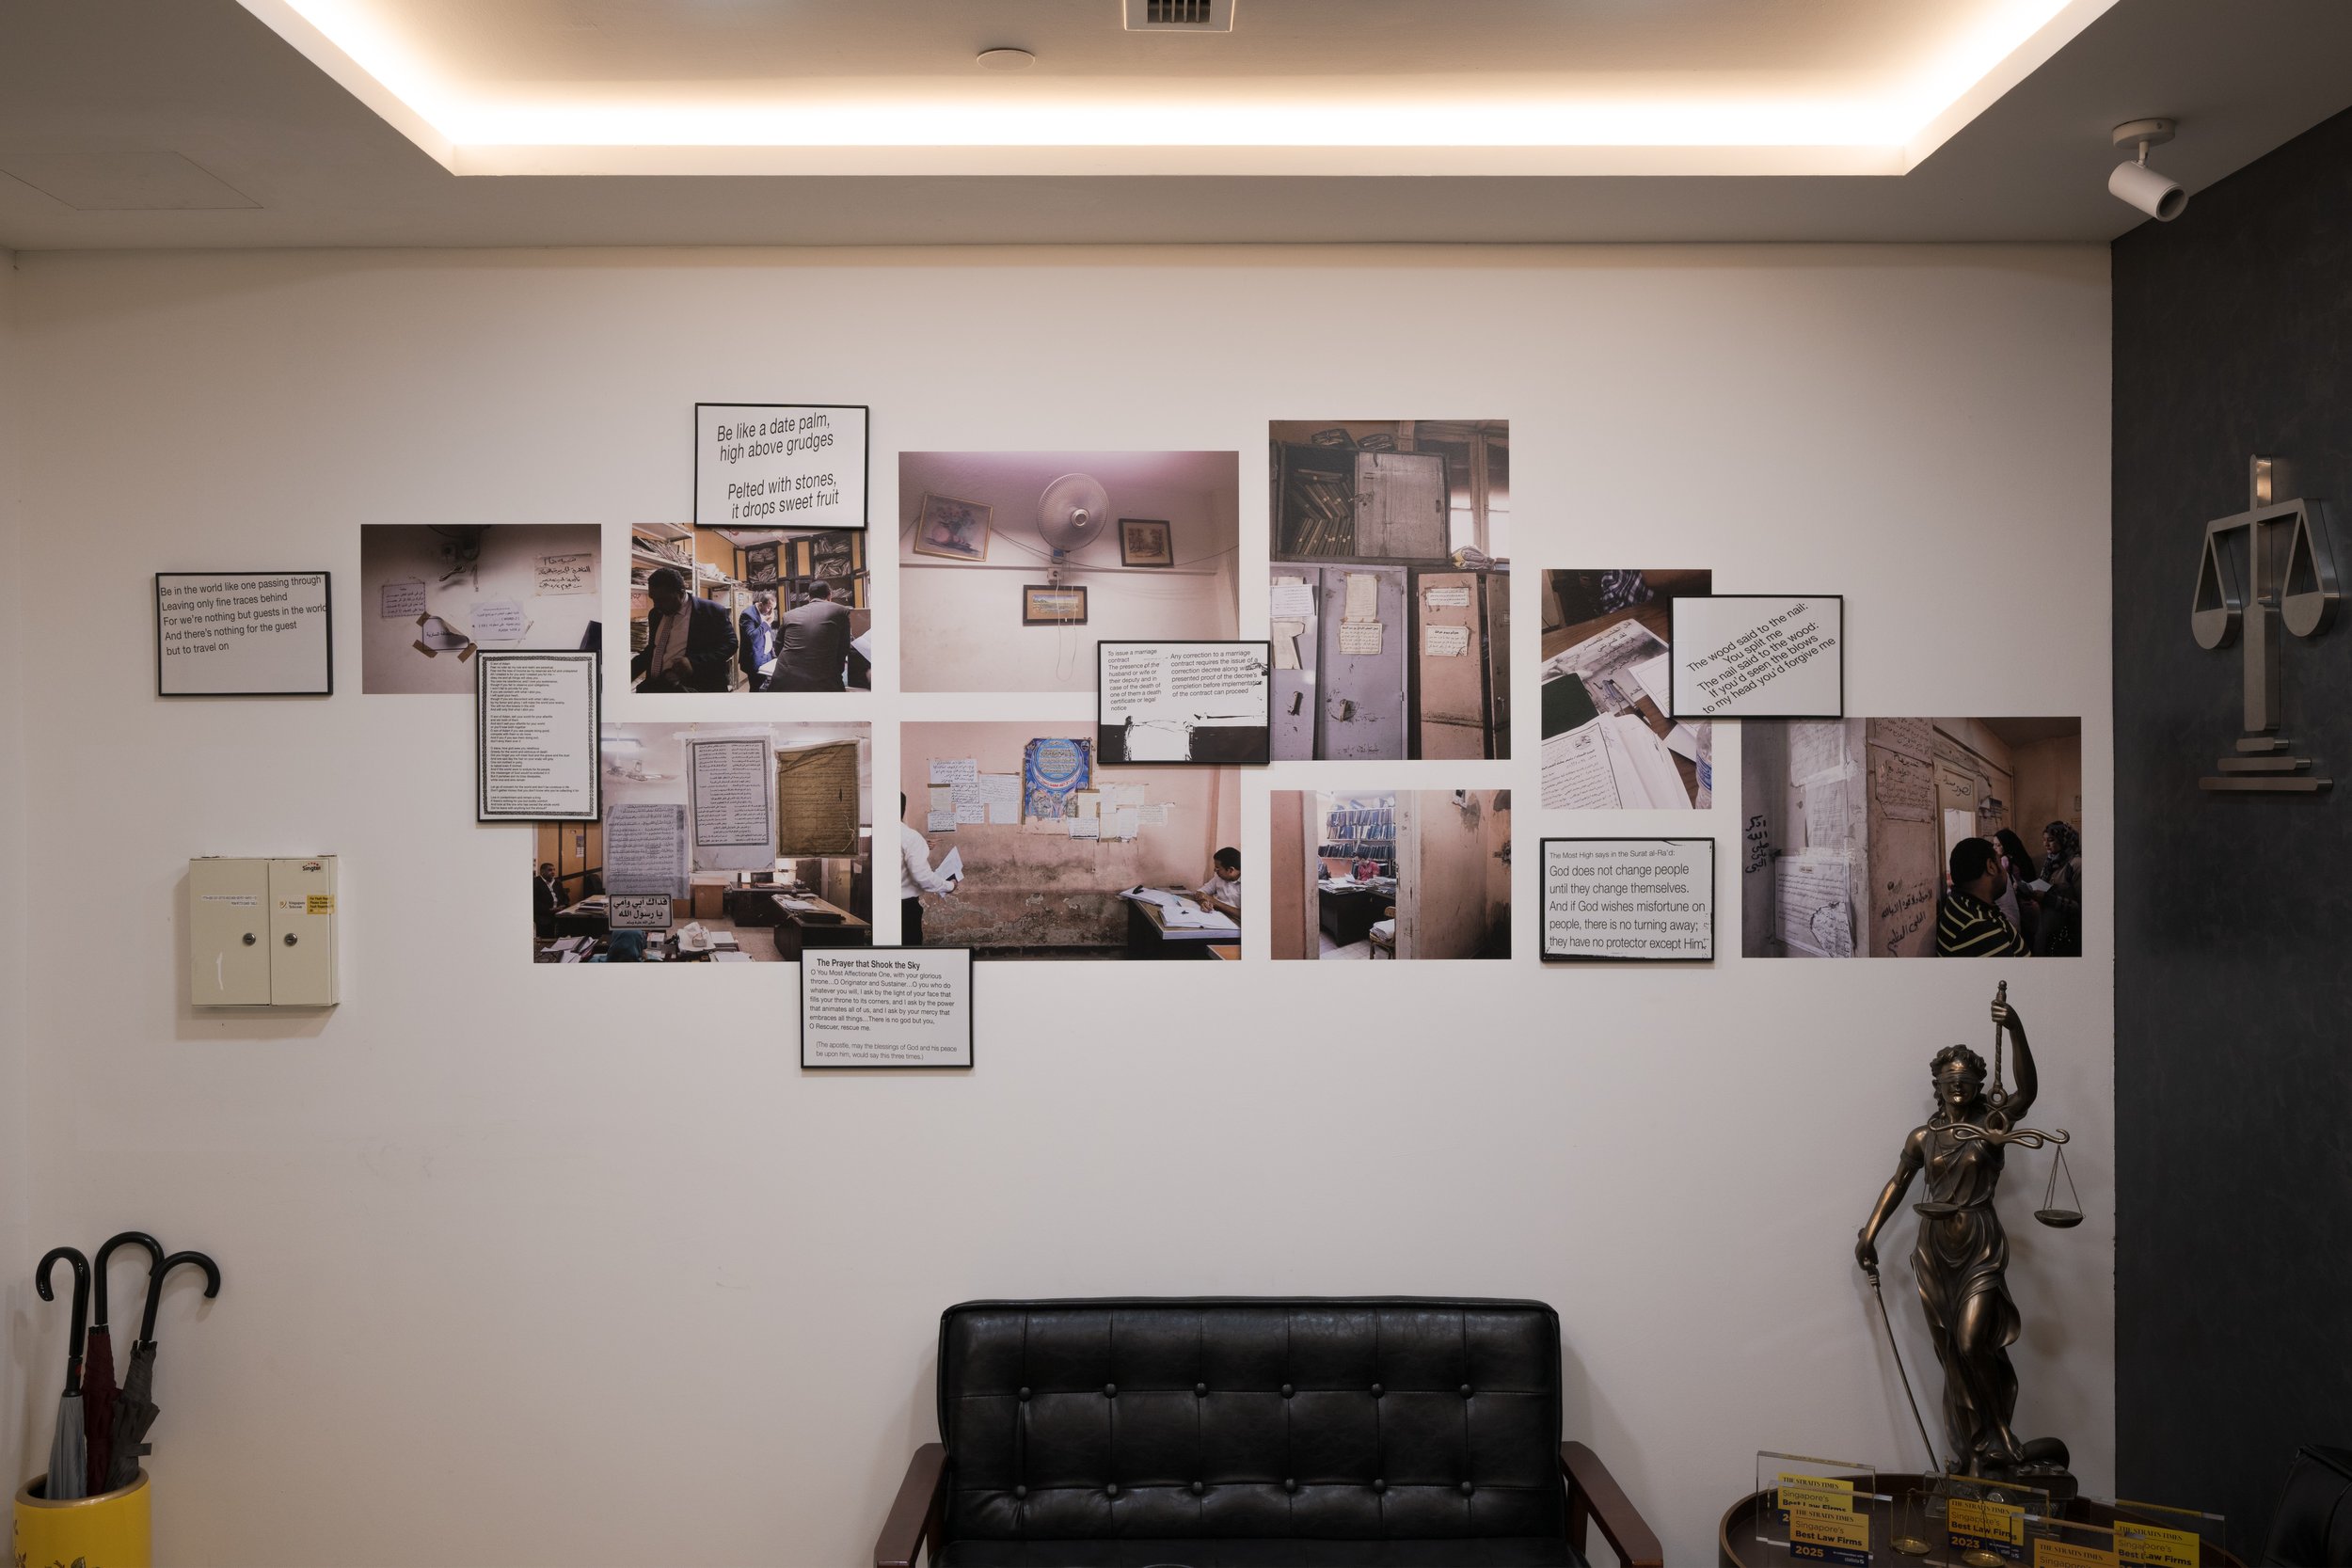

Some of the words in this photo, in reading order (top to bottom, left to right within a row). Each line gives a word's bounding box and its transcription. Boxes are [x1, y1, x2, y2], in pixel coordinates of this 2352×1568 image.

[718, 426, 733, 442] Be
[737, 422, 755, 439] like
[760, 424, 766, 436] a
[770, 418, 795, 435] date
[799, 412, 830, 435] palm,
[720, 444, 744, 464] high
[748, 440, 784, 458] above
[787, 434, 834, 456] grudges
[728, 480, 765, 499] Pelted
[769, 476, 792, 494] with
[795, 473, 836, 491] stones,
[732, 503, 739, 519] it
[742, 501, 775, 518] drops
[779, 494, 813, 513] sweet
[817, 489, 839, 507] fruit
[161, 587, 172, 596] Be
[175, 587, 182, 595] in
[184, 585, 198, 594] the
[199, 583, 222, 594] world
[225, 582, 239, 592] like
[241, 582, 256, 591] one
[259, 578, 289, 591] passing
[292, 576, 322, 586] through
[162, 600, 195, 611] Leaving
[197, 598, 214, 610] only
[216, 597, 231, 607] fine
[233, 595, 259, 605] traces
[261, 593, 288, 603] behind
[164, 616, 177, 626] For
[180, 615, 202, 624] we're
[205, 612, 235, 623] nothing
[238, 610, 251, 619] but
[253, 608, 280, 620] guests
[292, 606, 304, 614] the
[166, 631, 182, 641] And
[184, 628, 212, 638] there's
[215, 626, 245, 637] nothing
[246, 625, 258, 633] for
[261, 624, 273, 632] the
[276, 622, 297, 631] guest
[1686, 658, 1708, 673] The
[1708, 641, 1737, 661] wood
[1737, 630, 1758, 646] said
[1757, 625, 1770, 634] to
[1769, 614, 1788, 627] the
[1787, 602, 1808, 619] nail:
[167, 647, 181, 656] but
[194, 643, 216, 653] travel
[1723, 651, 1744, 665] You
[1744, 639, 1766, 656] split
[1766, 629, 1783, 642] me
[1697, 677, 1719, 691] The
[1719, 666, 1738, 682] nail
[1738, 655, 1759, 671] said
[1758, 649, 1771, 657] to
[1770, 639, 1788, 652] the
[1788, 622, 1820, 642] wood:
[1708, 689, 1719, 698] If
[1719, 673, 1747, 695] you'd
[1747, 661, 1772, 678] seen
[1771, 651, 1788, 664] the
[1788, 636, 1819, 655] blows
[1703, 705, 1715, 715] to
[1716, 696, 1732, 708] my
[1730, 682, 1757, 699] head
[1757, 665, 1786, 687] you'd
[1784, 648, 1820, 669] forgive
[1819, 637, 1836, 651] me
[1580, 851, 1594, 860] High
[1549, 865, 1569, 876] God
[1572, 865, 1595, 876] does
[1598, 866, 1613, 876] not
[1616, 864, 1652, 878] change
[1655, 863, 1689, 877] people
[1549, 883, 1568, 894] until
[1571, 883, 1590, 895] they
[1593, 883, 1628, 895] change
[1630, 883, 1689, 894] themselves.
[1549, 901, 1568, 911] And
[1570, 901, 1576, 911] if
[1578, 901, 1598, 911] God
[1601, 901, 1634, 911] wishes
[1637, 900, 1689, 912] misfortune
[1692, 901, 1706, 911] on
[1549, 919, 1582, 931] people,
[1584, 919, 1607, 929] there
[1610, 919, 1617, 929] is
[1620, 920, 1631, 930] no
[1634, 920, 1667, 933] turning
[1670, 922, 1698, 933] away;
[1549, 936, 1567, 948] they
[1569, 937, 1590, 947] have
[1593, 938, 1604, 948] no
[1607, 938, 1647, 950] protector
[1650, 939, 1681, 951] except
[817, 958, 830, 967] The
[832, 959, 854, 969] Prayer
[871, 960, 893, 969] Shook
[908, 961, 920, 971] Sky
[1807, 1511, 1835, 1521] STRAITS
[1796, 1521, 1844, 1534] Singapore's
[1818, 1532, 1836, 1542] Law
[1837, 1535, 1863, 1546] Firms
[1796, 1545, 1824, 1558] 2025
[2165, 1555, 2192, 1565] Firms
